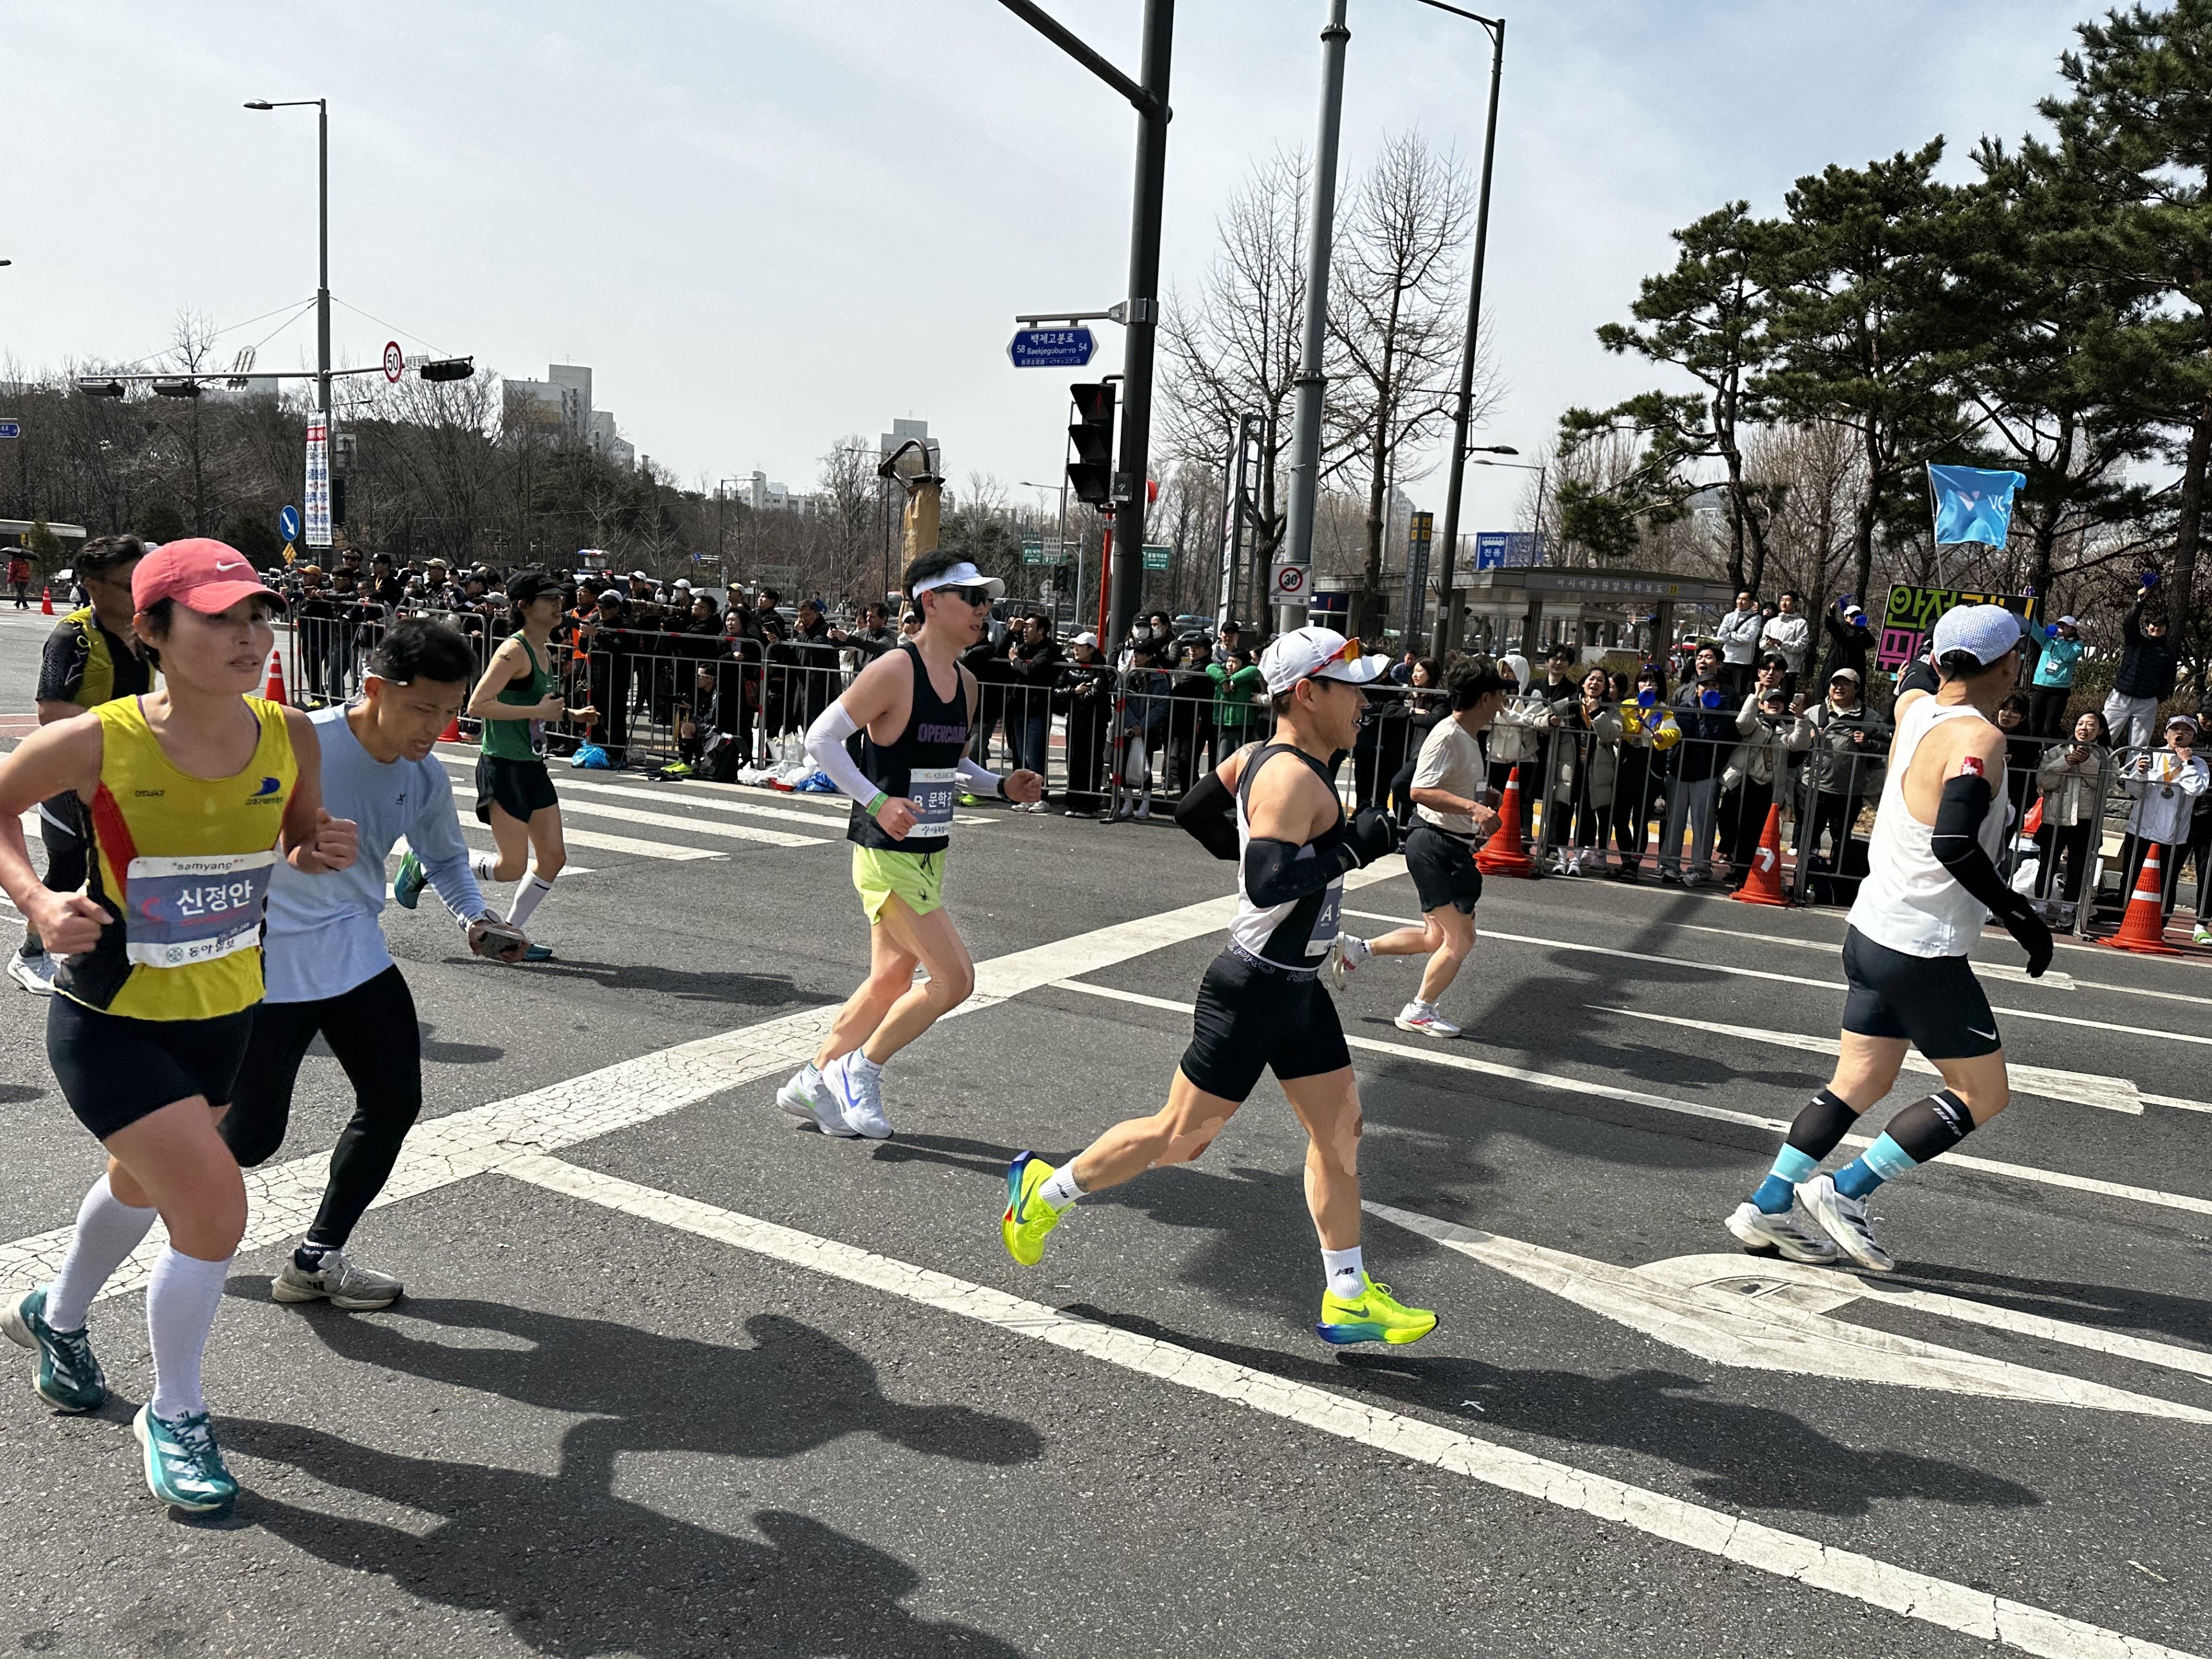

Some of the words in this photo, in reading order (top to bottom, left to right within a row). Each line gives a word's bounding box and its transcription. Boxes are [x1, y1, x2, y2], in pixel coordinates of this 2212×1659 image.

[1031, 332, 1074, 345] 백제고분로
[1017, 344, 1025, 353] 58
[1027, 347, 1076, 355] Baekjegobun-ro
[1078, 343, 1088, 351] 54
[388, 353, 399, 372] 50
[1484, 548, 1501, 557] 전용
[1285, 574, 1297, 585] 30
[914, 795, 923, 808] B
[176, 880, 253, 916] 신정안
[1320, 904, 1332, 922] A
